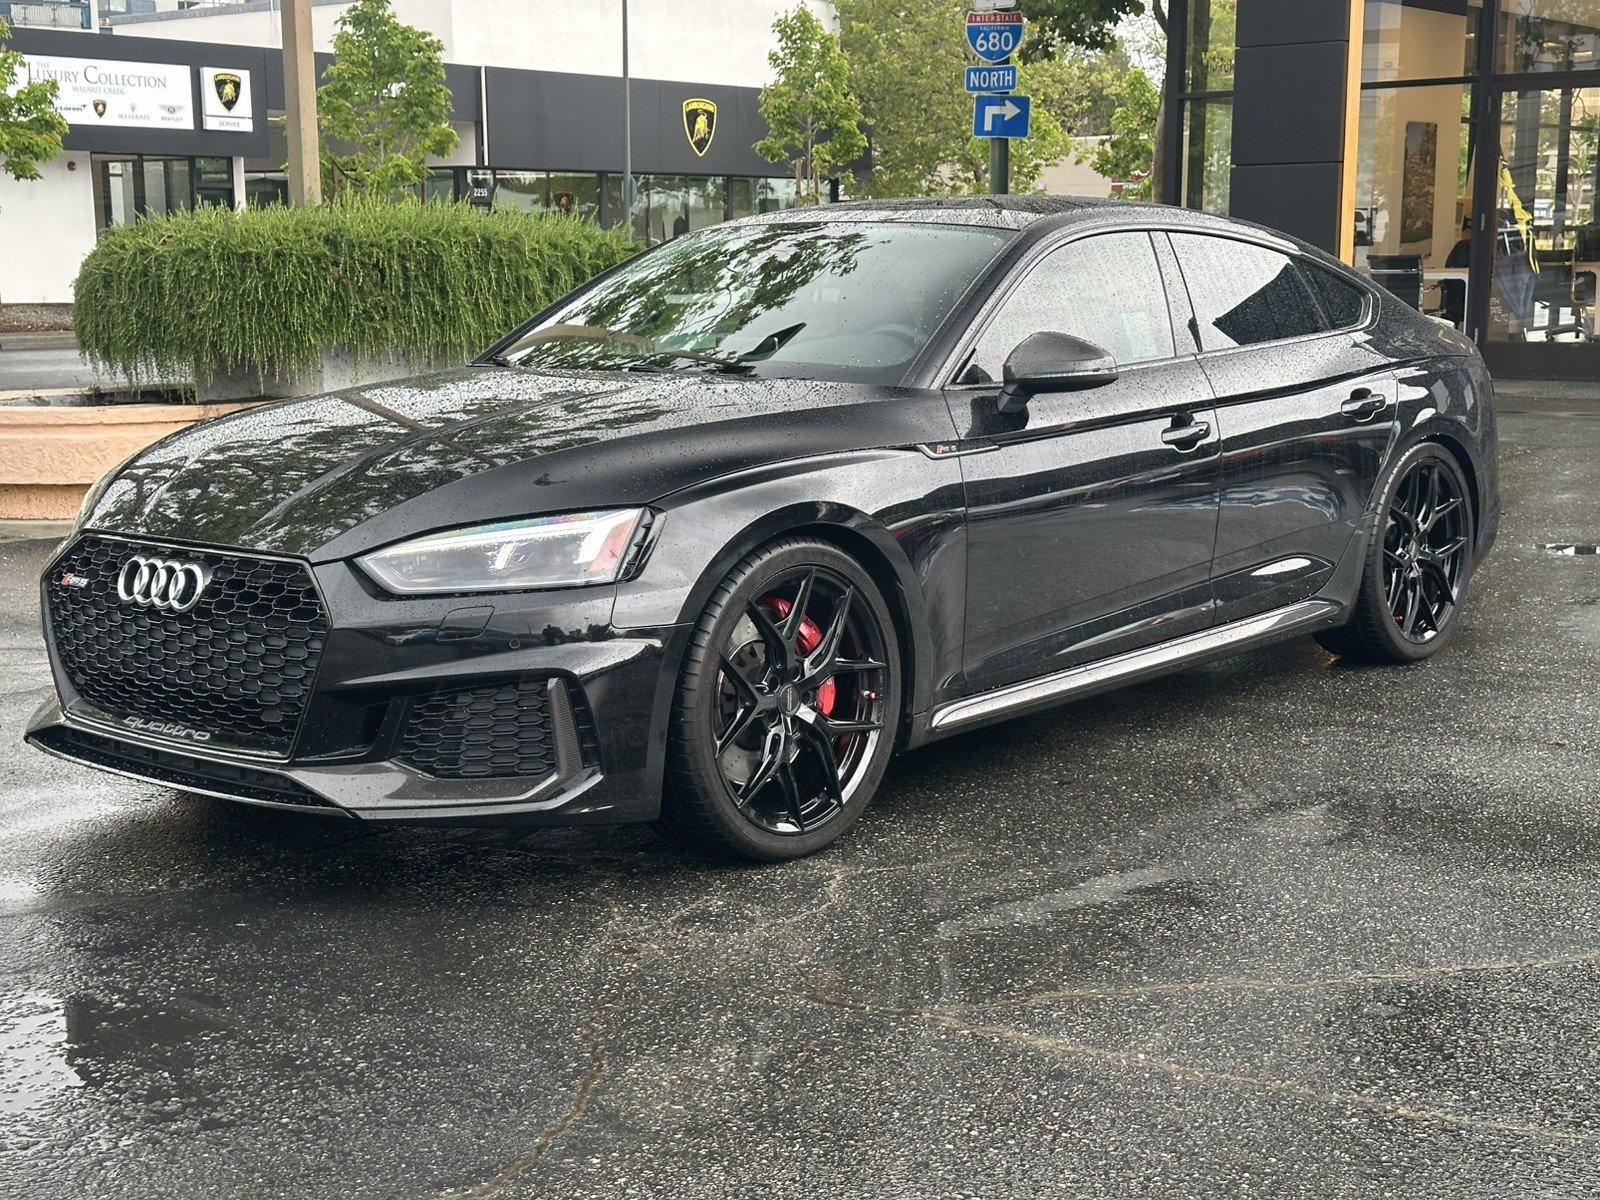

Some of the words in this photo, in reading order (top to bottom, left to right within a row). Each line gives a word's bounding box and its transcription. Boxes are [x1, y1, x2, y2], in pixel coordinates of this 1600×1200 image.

[972, 14, 1018, 22] INTERSTATE
[976, 31, 1013, 52] 680
[83, 64, 167, 89] COLLECTION
[969, 69, 1013, 88] NORTH
[72, 85, 102, 94] WALNUT
[473, 187, 488, 197] 2255
[123, 715, 211, 740] quattro
